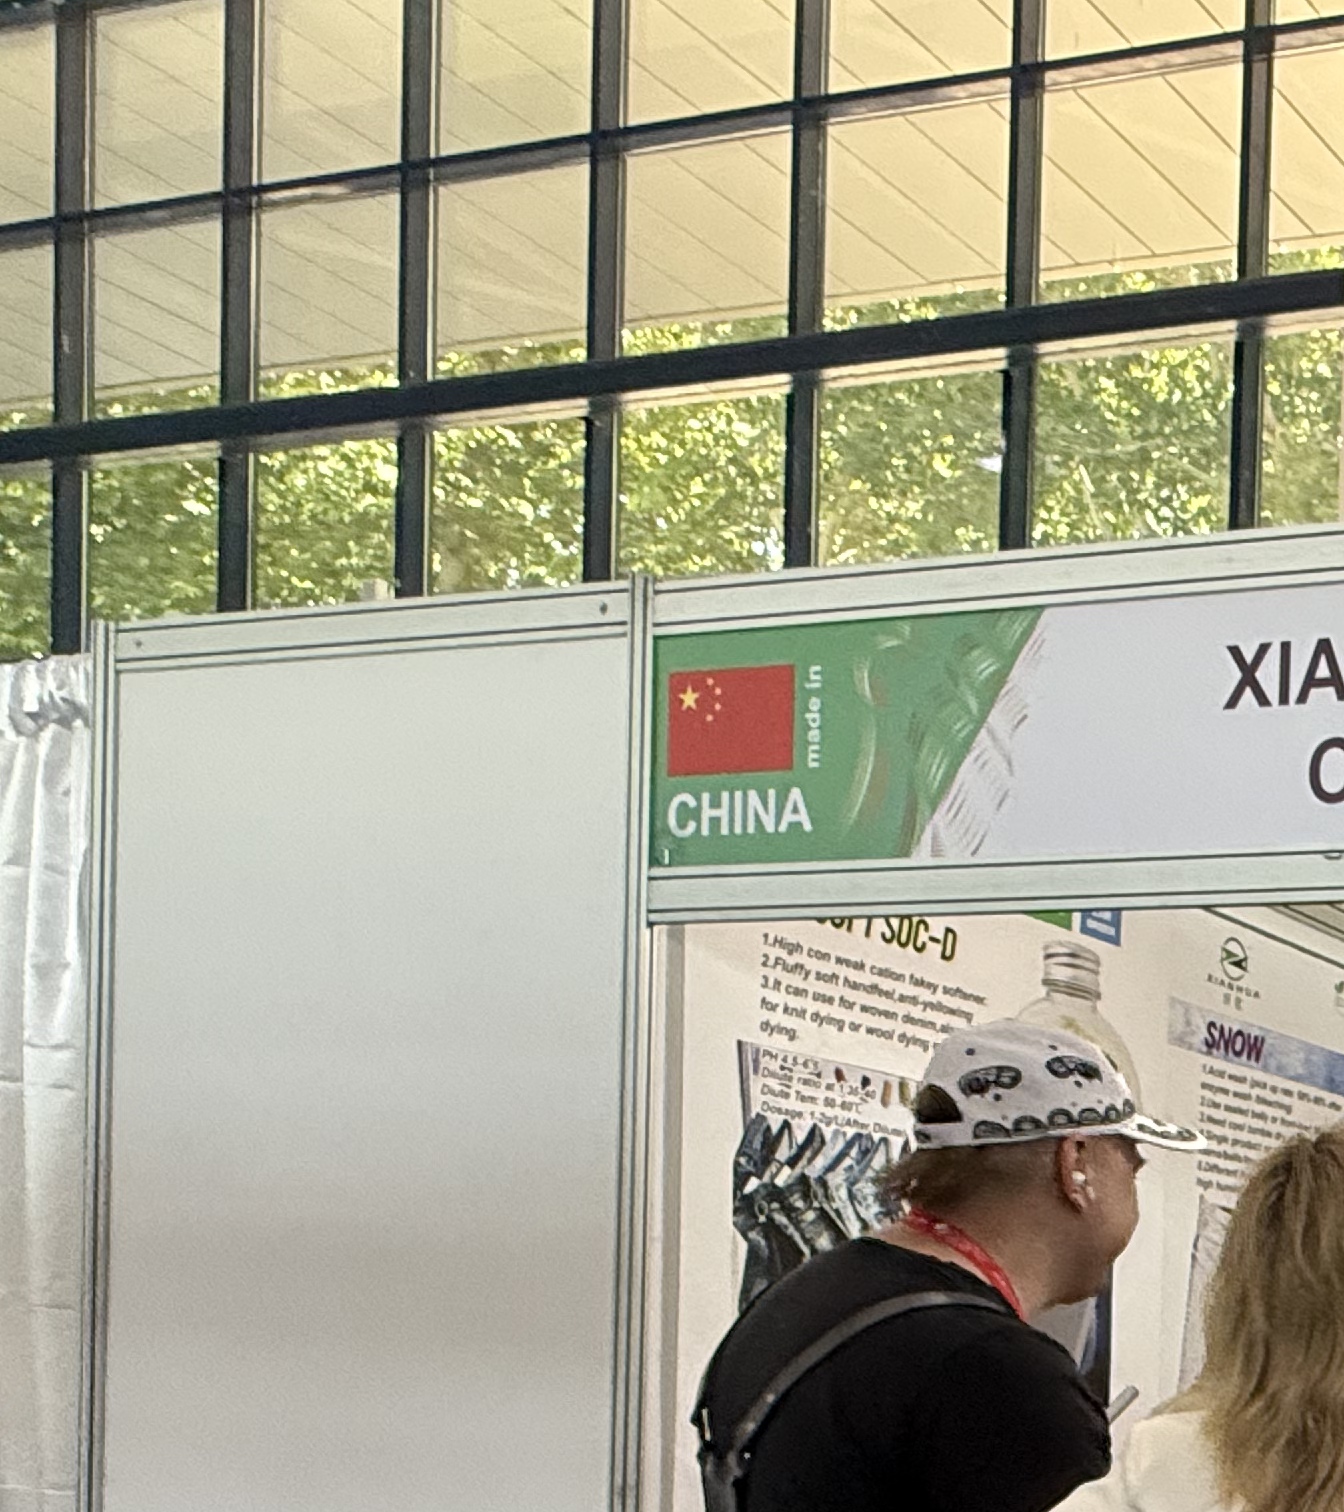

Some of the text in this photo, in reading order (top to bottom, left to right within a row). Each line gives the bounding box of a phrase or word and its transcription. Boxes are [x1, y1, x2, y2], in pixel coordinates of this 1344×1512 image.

[804, 664, 823, 768] made in
[667, 786, 813, 838] CHINA
[760, 996, 780, 1013] for
[847, 1020, 863, 1033] or
[785, 981, 809, 999] can
[812, 989, 836, 1007] use
[838, 995, 858, 1012] for
[1204, 1020, 1266, 1065] SNOW
